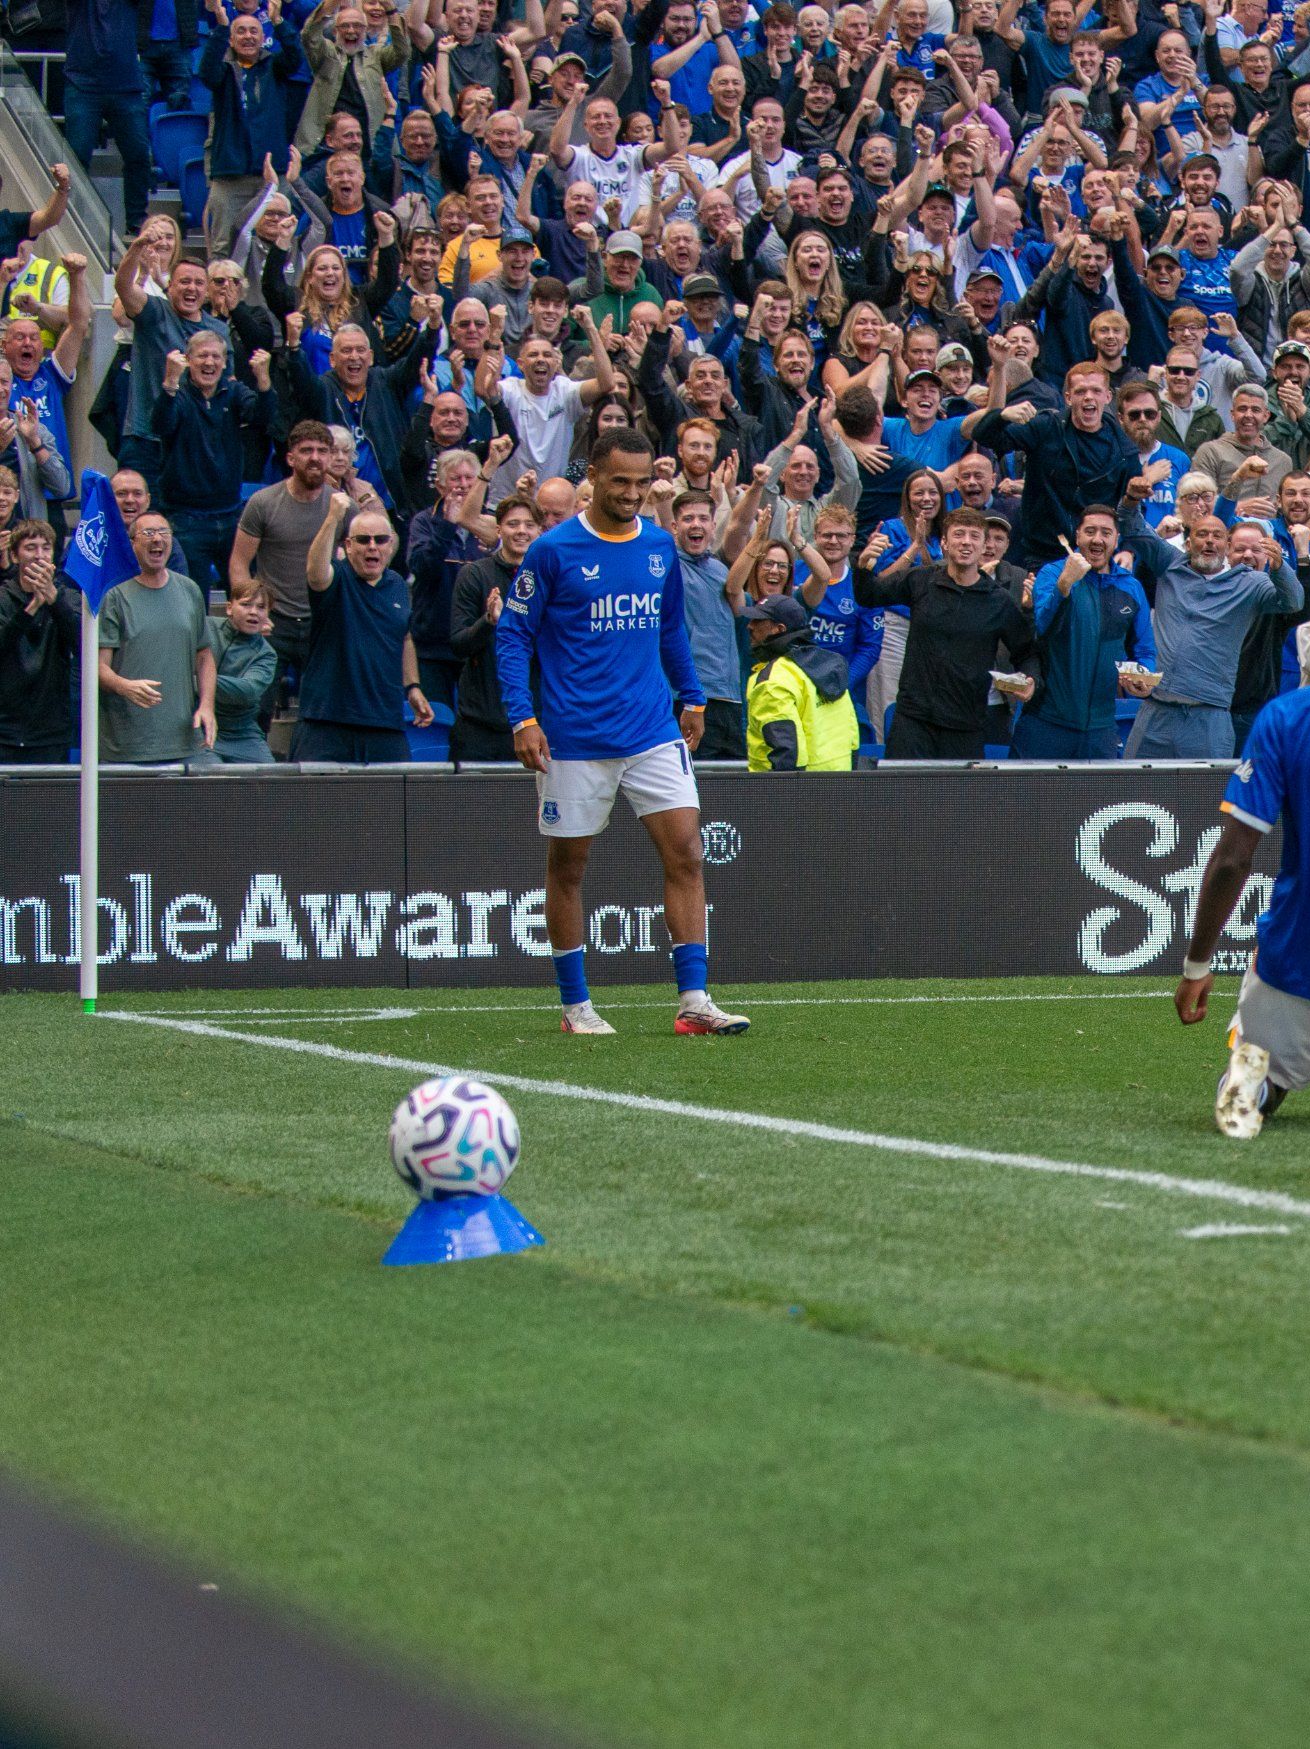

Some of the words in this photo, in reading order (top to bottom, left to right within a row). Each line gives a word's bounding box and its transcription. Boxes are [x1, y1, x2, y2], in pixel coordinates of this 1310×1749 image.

[1193, 284, 1232, 296] SportPe
[614, 592, 662, 617] CMC
[590, 616, 660, 633] MARKETS
[809, 616, 846, 635] CMC
[814, 632, 844, 643] KETS
[1075, 802, 1278, 974] Sta
